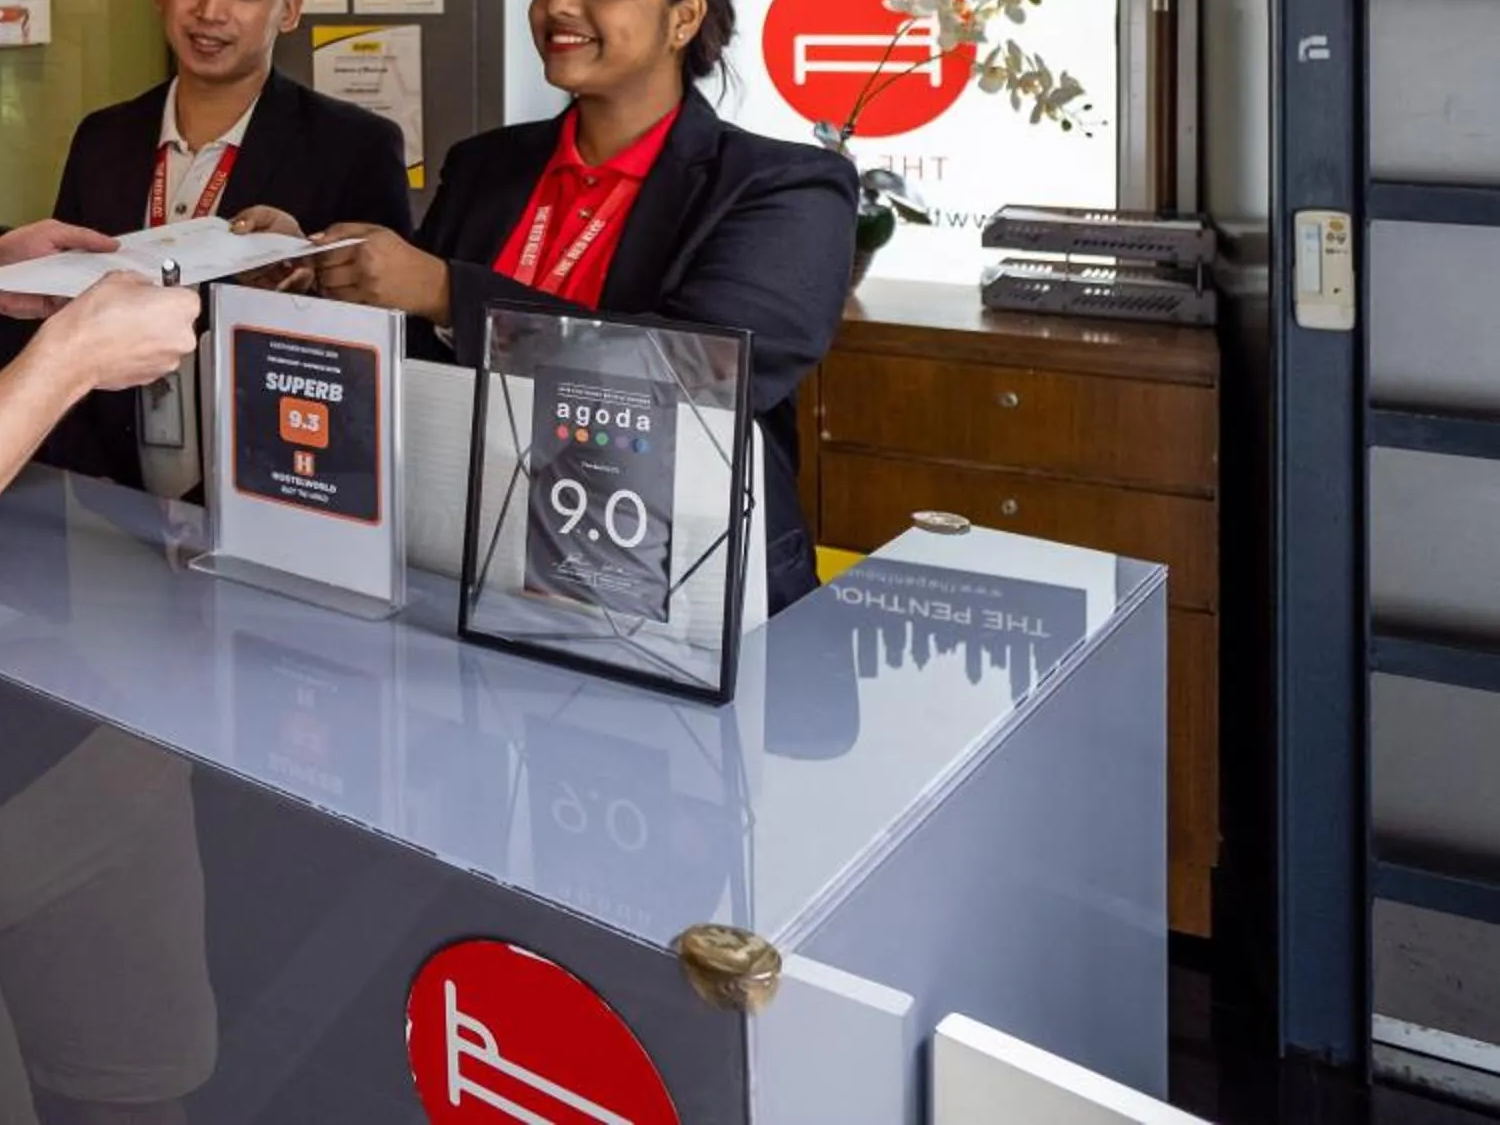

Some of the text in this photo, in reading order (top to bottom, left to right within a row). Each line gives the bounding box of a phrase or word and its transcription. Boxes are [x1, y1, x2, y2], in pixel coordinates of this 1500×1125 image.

[265, 372, 343, 403] SUPERB
[288, 410, 321, 433] 9.3
[556, 401, 651, 432] agoda
[550, 478, 648, 549] 9.0
[981, 608, 1051, 638] THE
